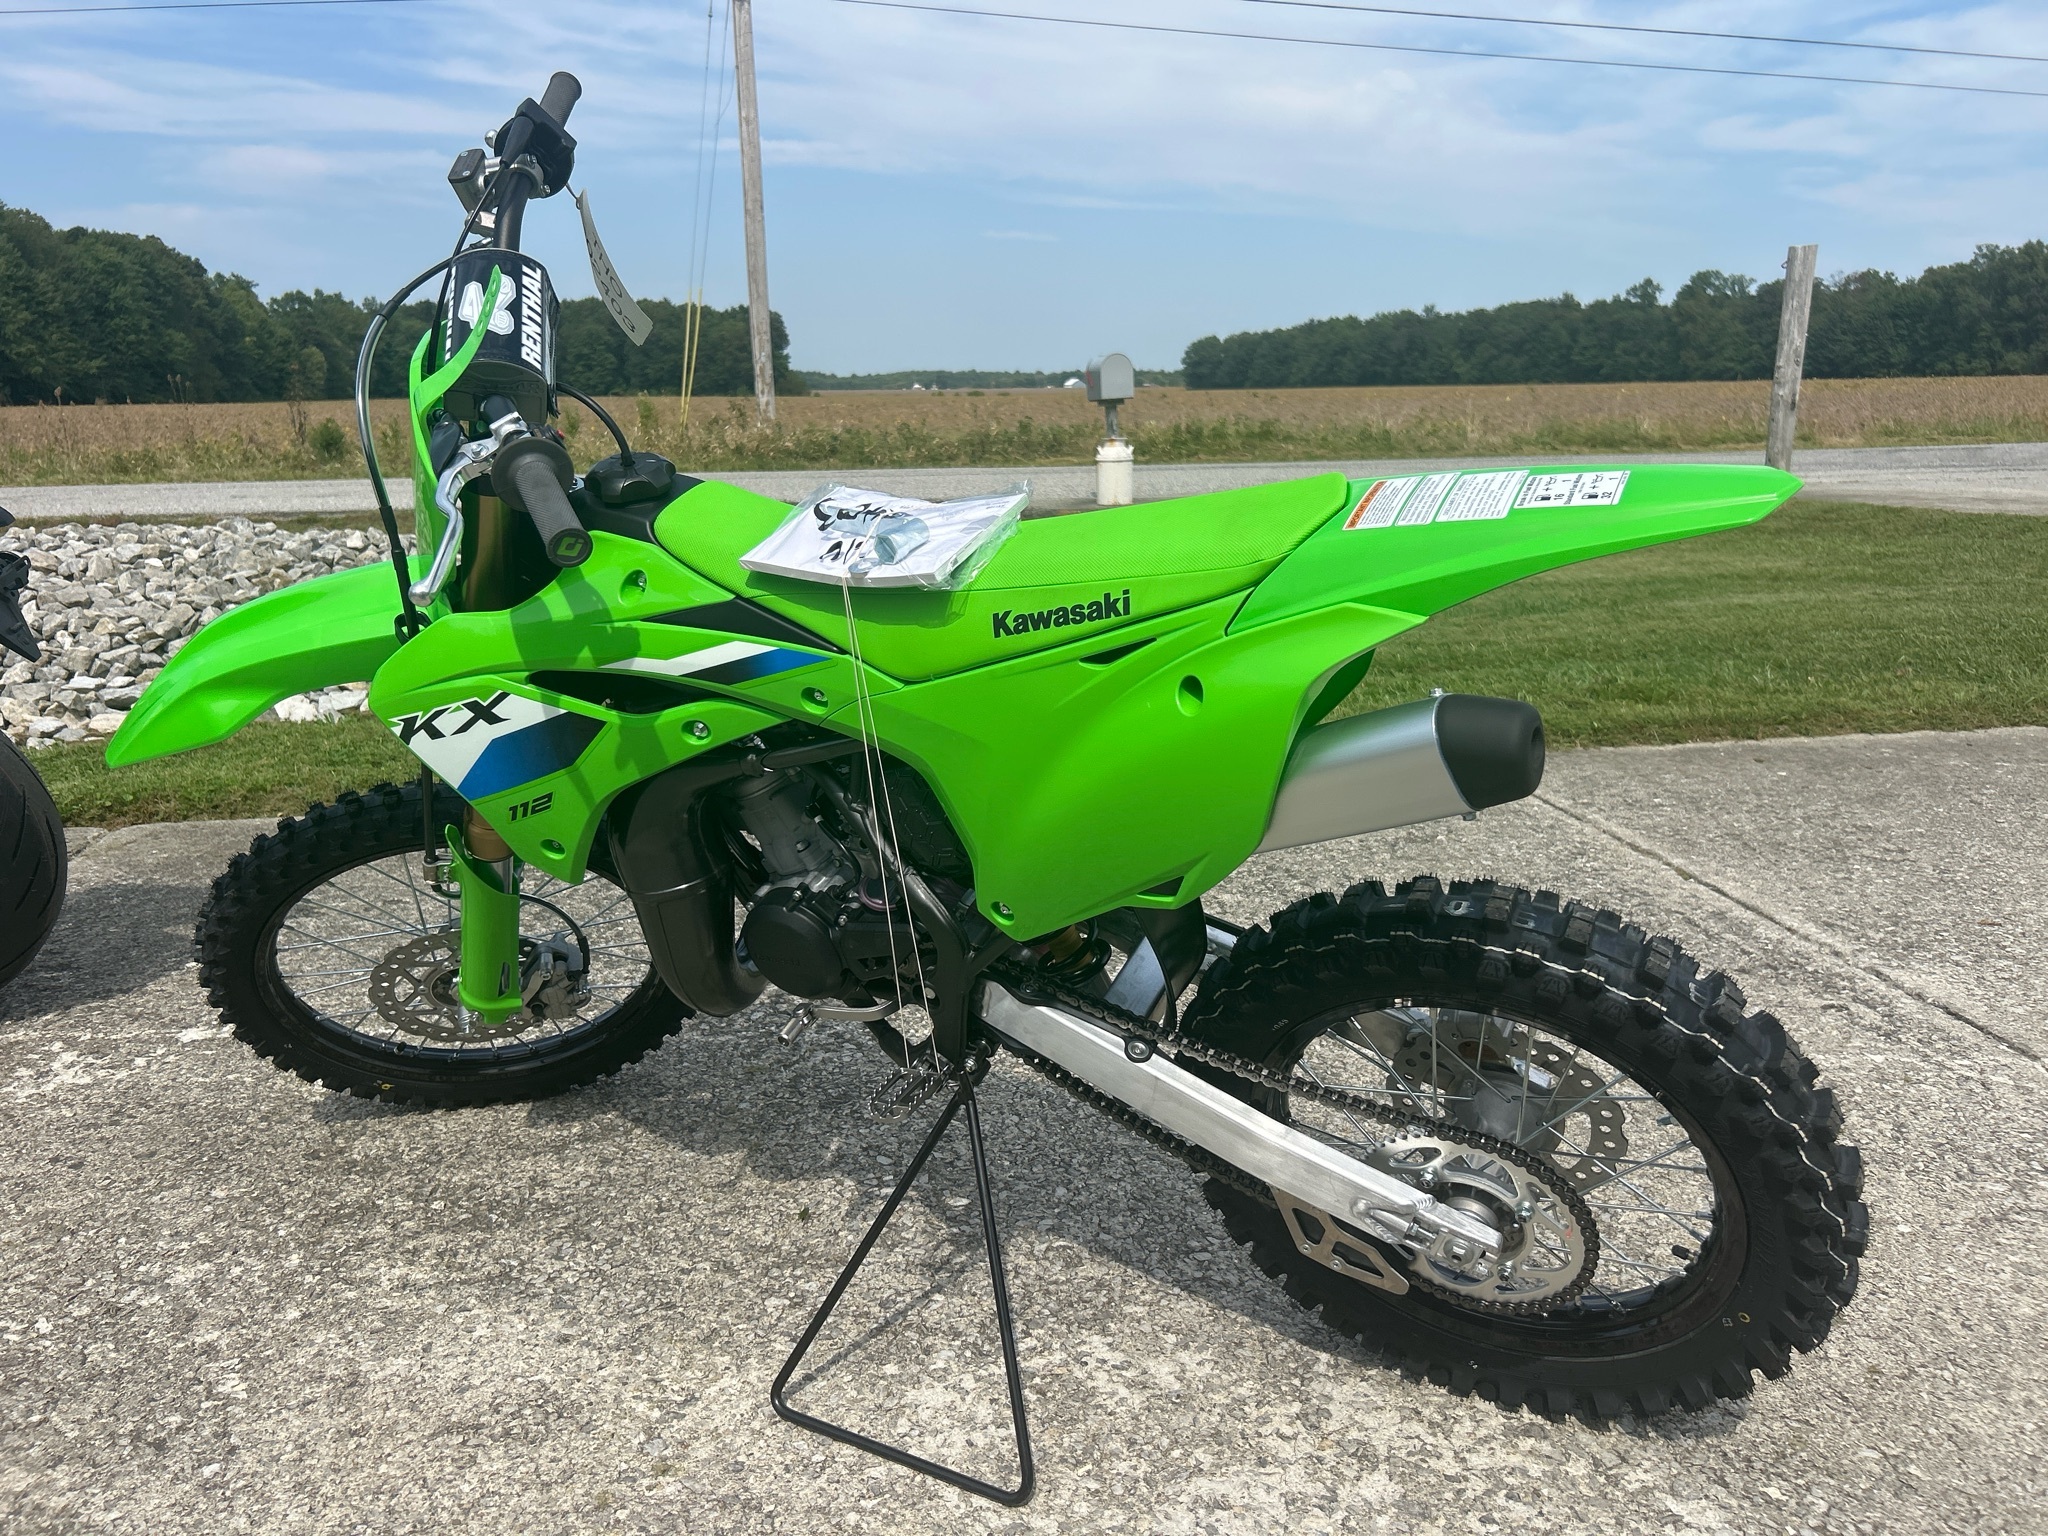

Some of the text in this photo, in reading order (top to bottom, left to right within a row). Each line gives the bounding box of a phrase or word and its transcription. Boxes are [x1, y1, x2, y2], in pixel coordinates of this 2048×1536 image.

[521, 264, 542, 371] RENTHAL
[1601, 491, 1612, 499] 32
[992, 589, 1130, 638] Kawasaki
[397, 691, 511, 745] KX
[509, 792, 553, 821] 112
